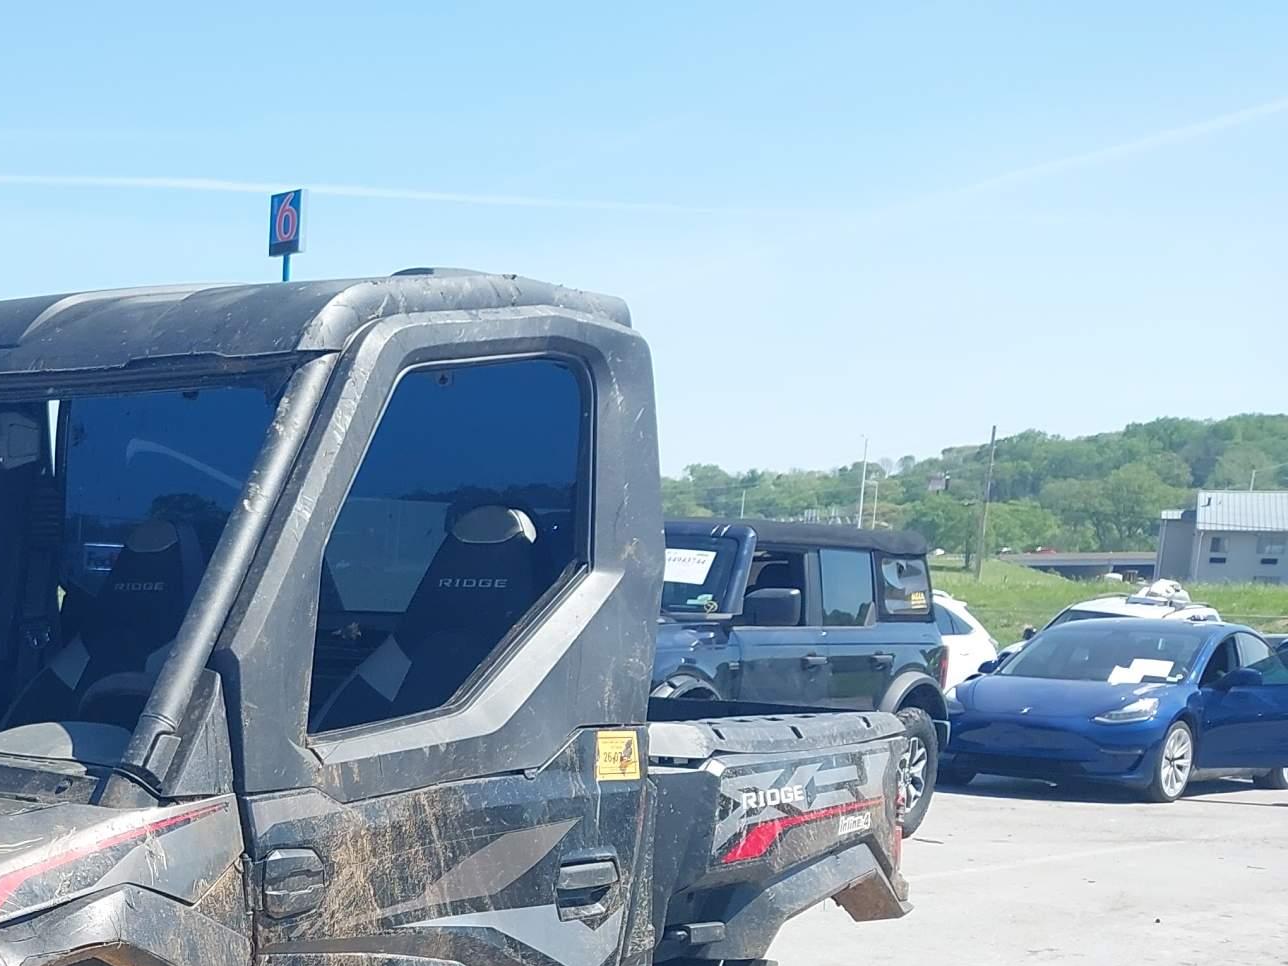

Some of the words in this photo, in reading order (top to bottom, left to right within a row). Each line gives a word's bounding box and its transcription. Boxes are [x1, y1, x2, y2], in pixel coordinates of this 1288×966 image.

[276, 192, 297, 242] 6
[114, 582, 165, 591] RIDGE
[439, 578, 508, 588] RIDGE
[742, 785, 805, 810] RIDGE
